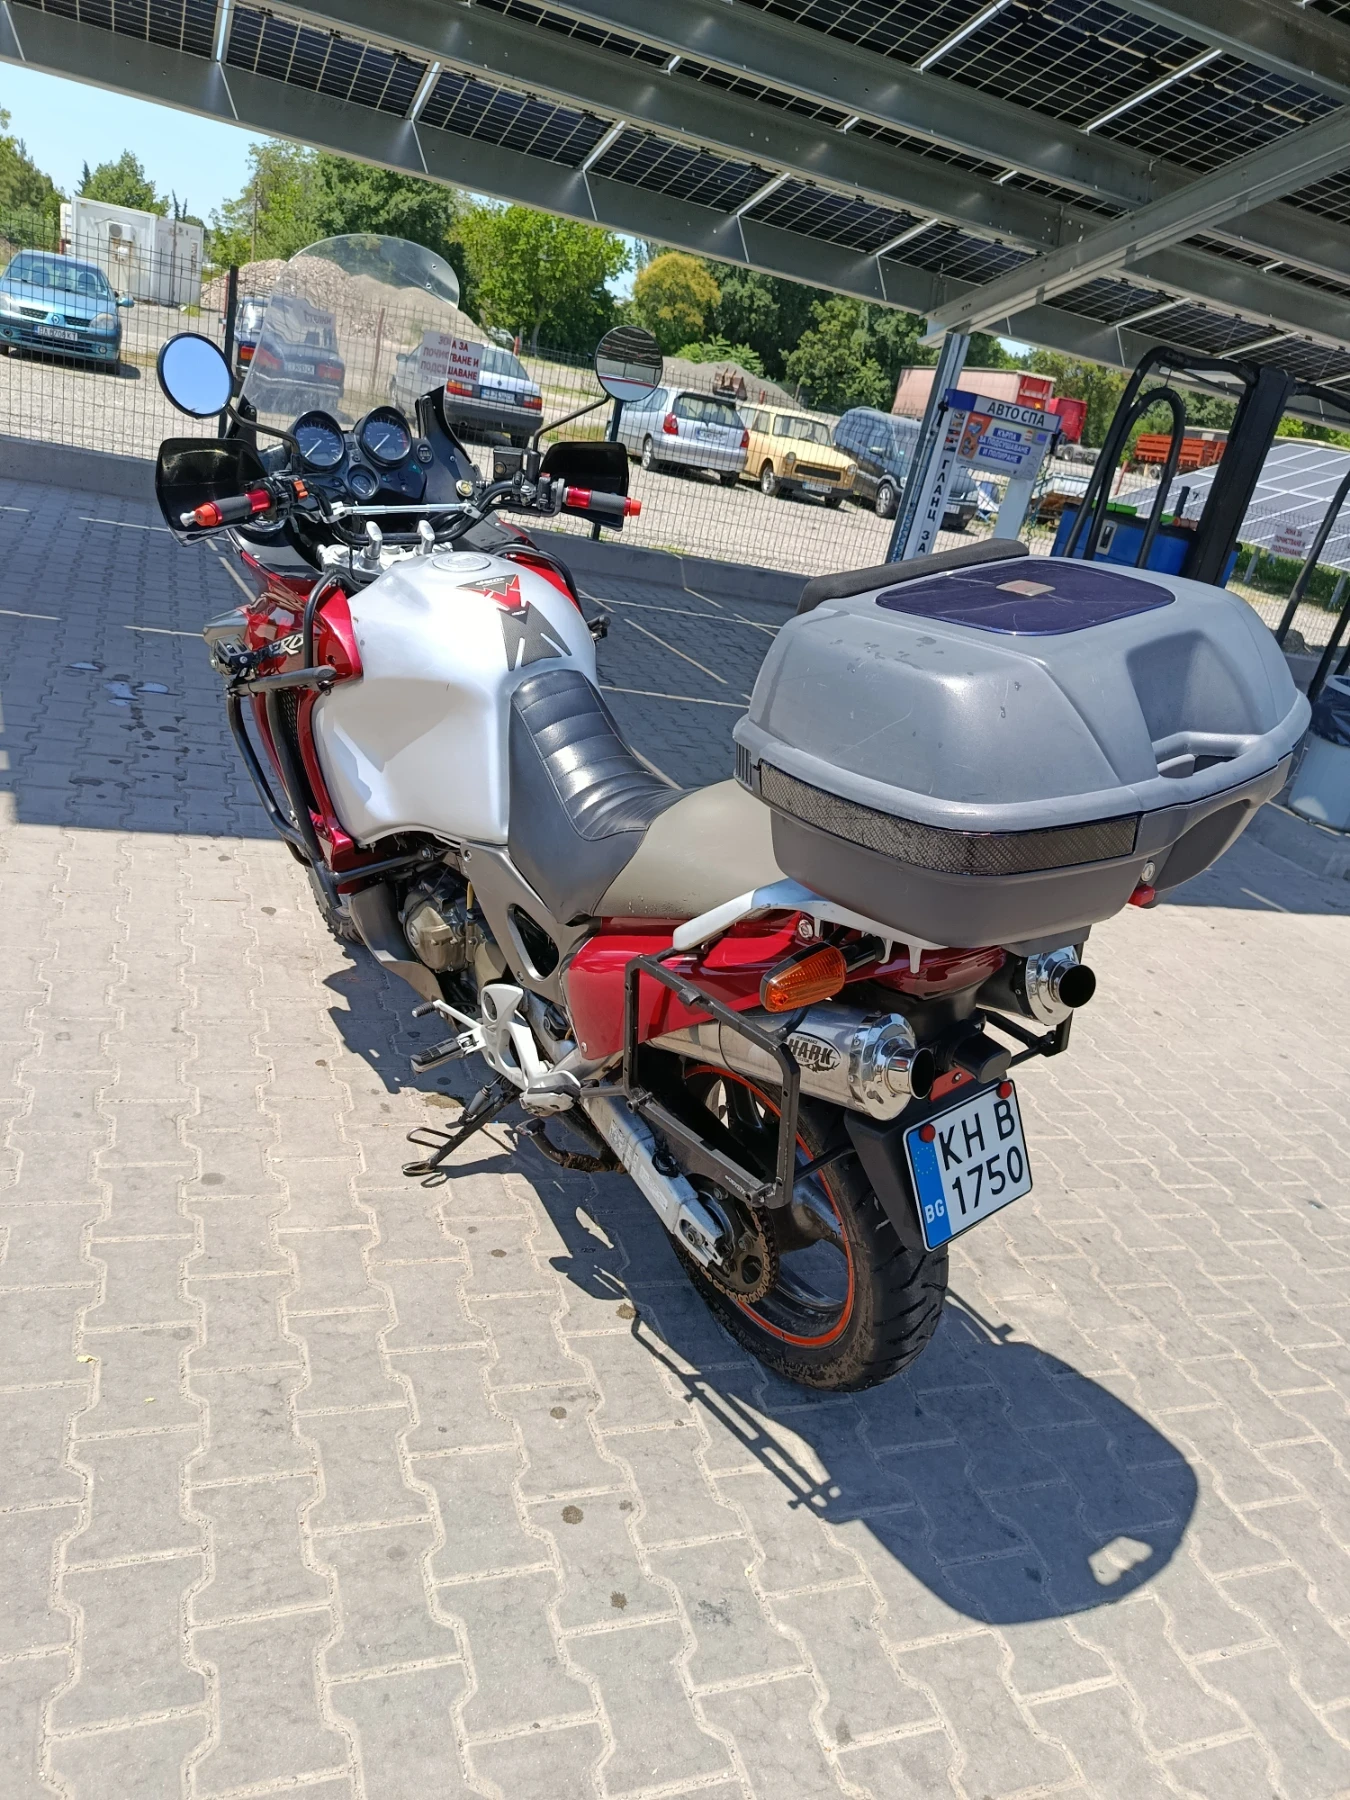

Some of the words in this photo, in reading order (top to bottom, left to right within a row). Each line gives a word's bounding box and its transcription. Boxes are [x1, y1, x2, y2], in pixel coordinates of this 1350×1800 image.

[458, 341, 469, 352] ЗА
[472, 358, 480, 368] И
[987, 402, 1020, 420] АВТО
[1021, 410, 1045, 427] СПА
[996, 429, 1017, 441] КЪРПА
[927, 459, 950, 522] ГЛАНЦ
[917, 530, 930, 553] ЗА
[788, 1038, 834, 1066] HARK
[939, 1112, 986, 1171] KH
[993, 1100, 1016, 1141] B
[952, 1145, 1024, 1216] 1750
[924, 1198, 945, 1224] BG
